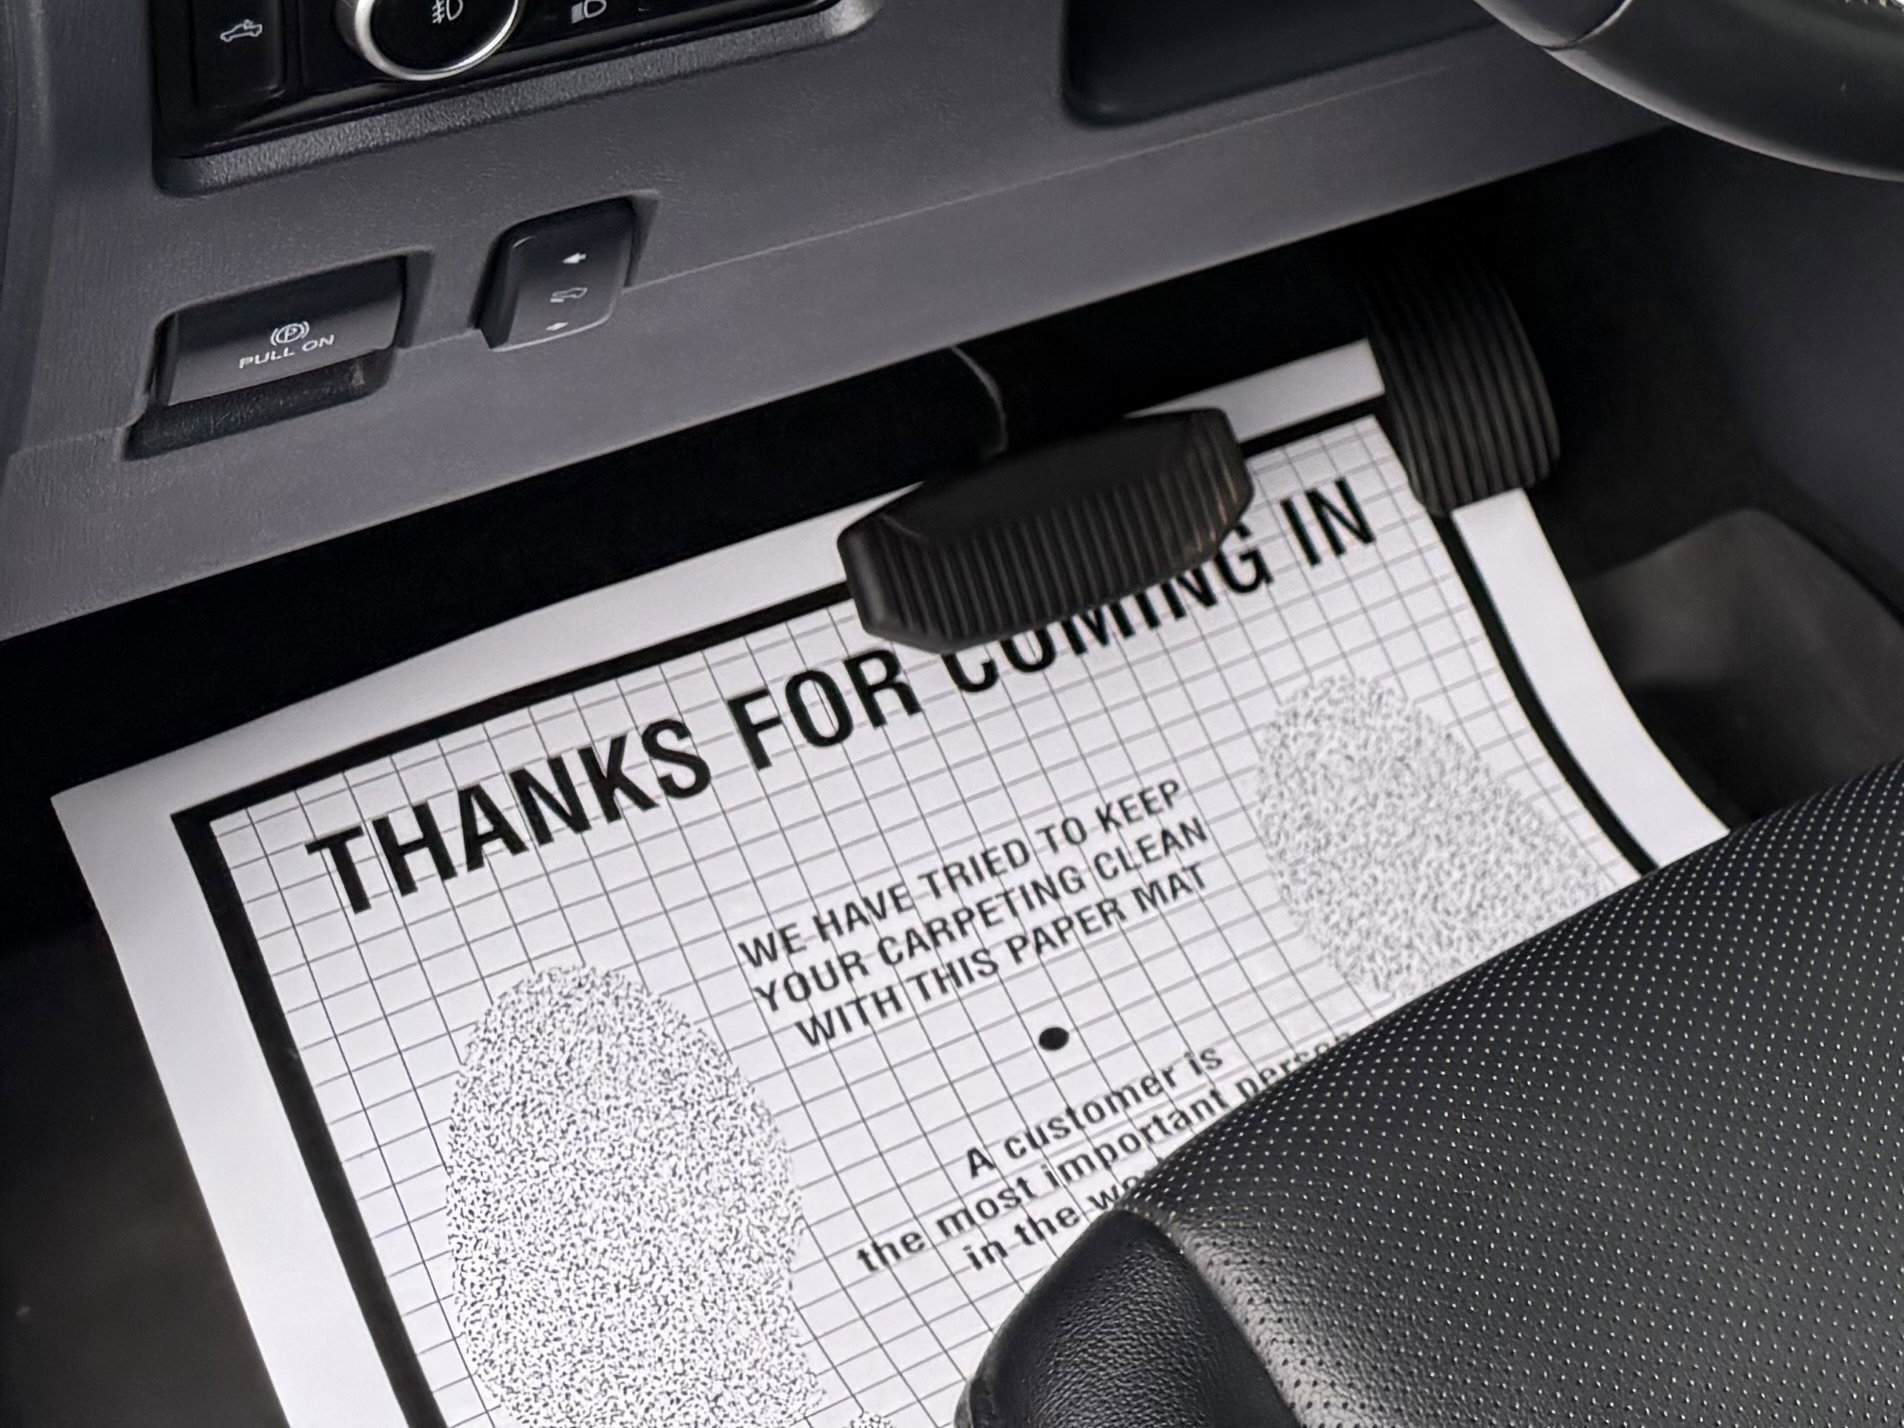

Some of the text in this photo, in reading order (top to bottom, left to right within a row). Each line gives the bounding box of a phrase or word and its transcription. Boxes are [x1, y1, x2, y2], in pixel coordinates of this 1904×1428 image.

[239, 334, 335, 369] PULL ON
[305, 718, 711, 915] THANKS
[726, 647, 922, 772] FOR
[1280, 475, 1377, 568] IN
[738, 778, 1182, 969] WE HAVE TRIED TO KEEP
[752, 816, 1209, 1012] YOUR CARPETING CLEAN
[794, 861, 1212, 1048] WITH THIS PAPER MAT
[856, 1230, 928, 1274] the
[934, 1175, 1041, 1240] most
[1043, 1089, 1231, 1190] important
[964, 1043, 1225, 1180] A customer is
[962, 1201, 1081, 1271] in the
